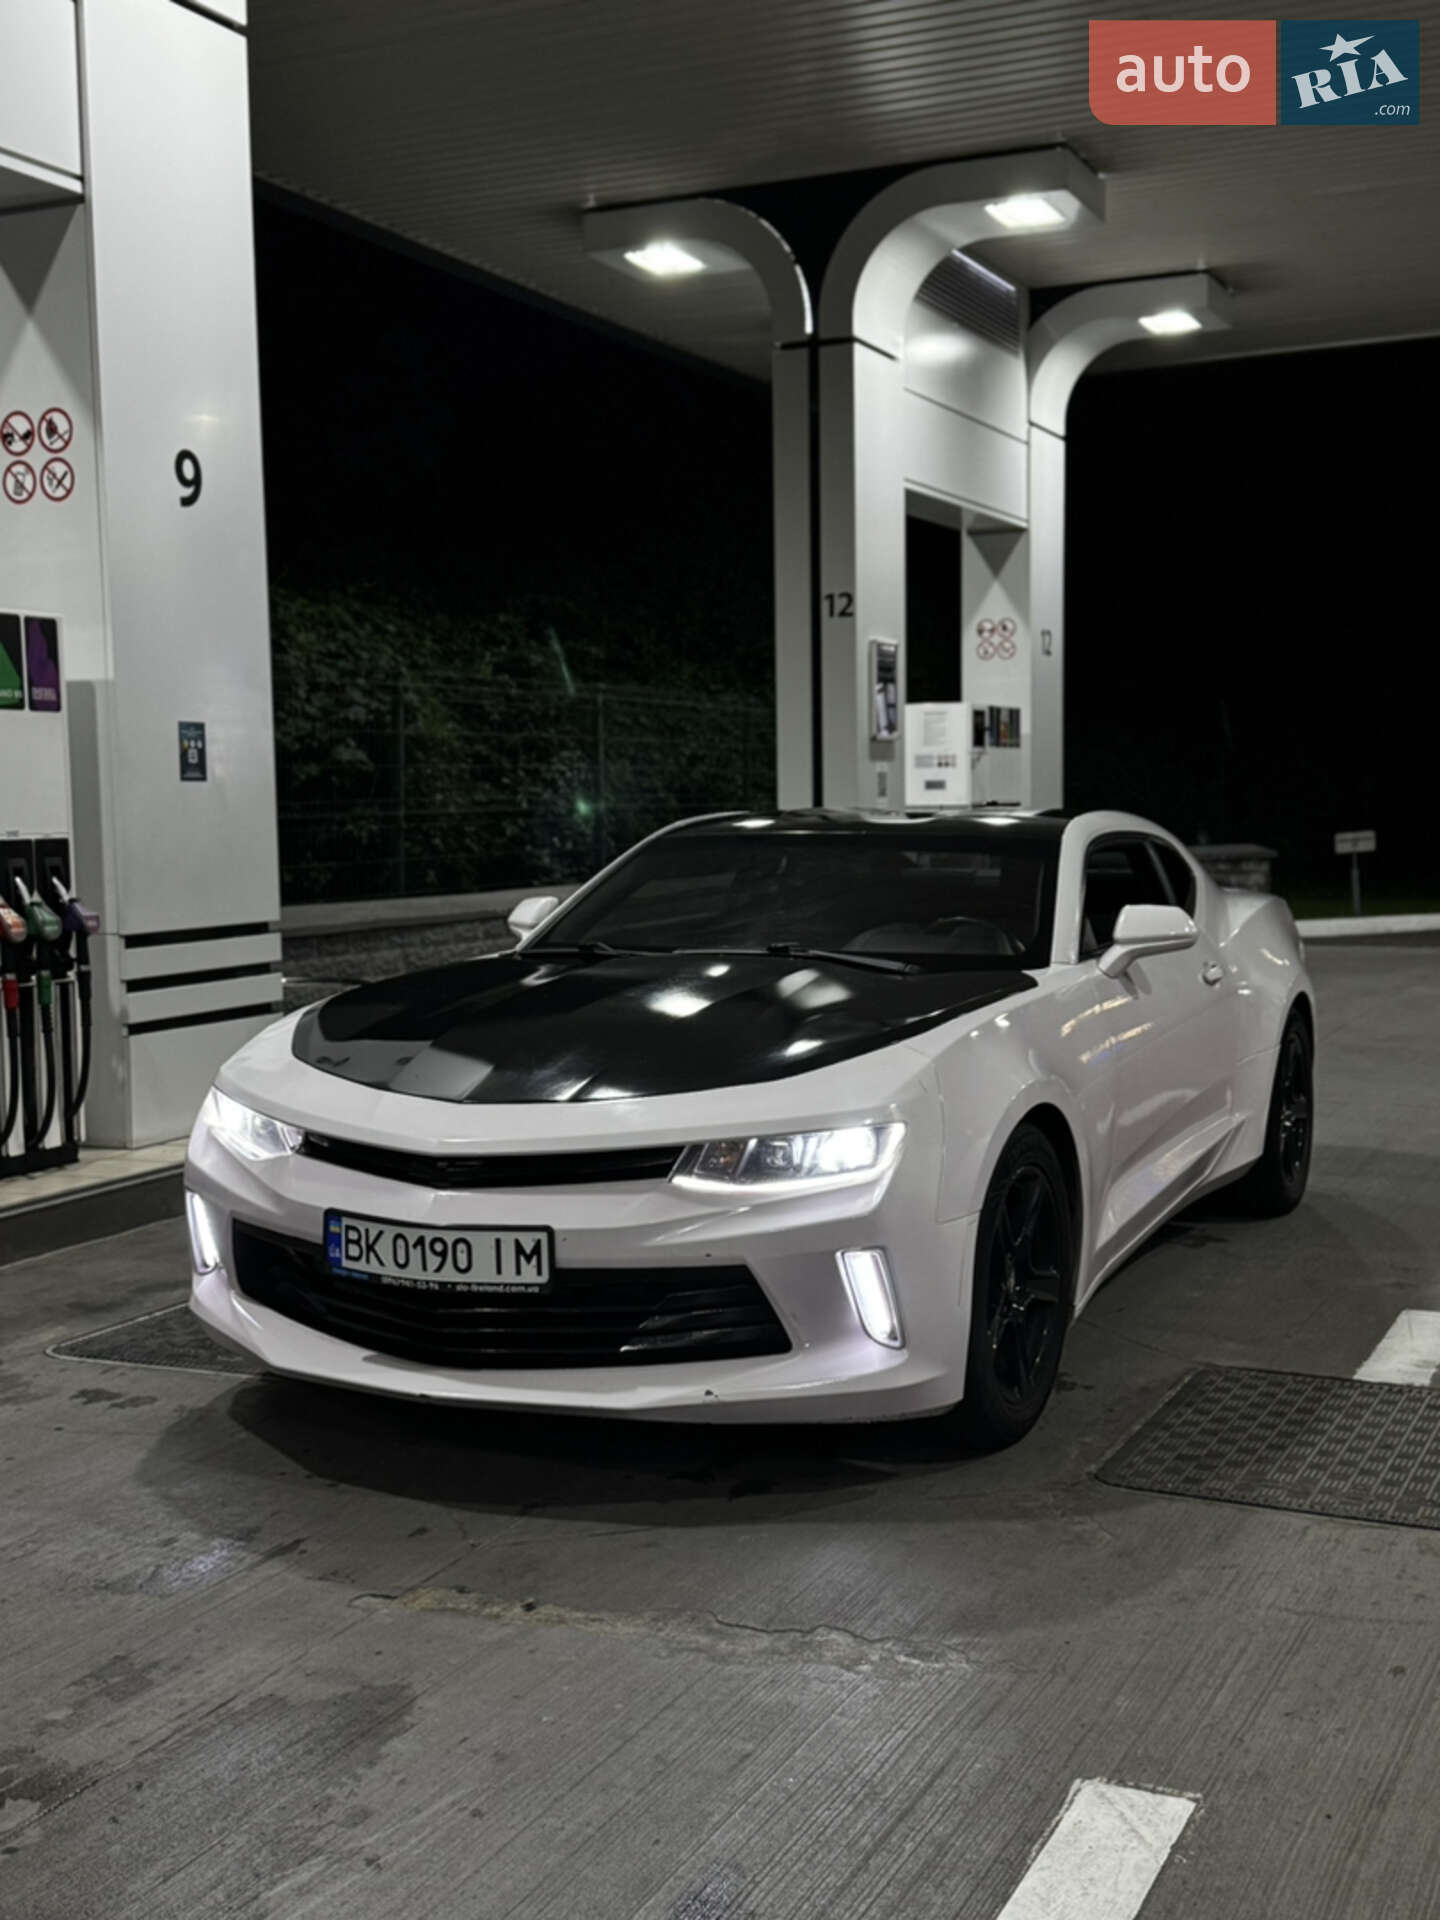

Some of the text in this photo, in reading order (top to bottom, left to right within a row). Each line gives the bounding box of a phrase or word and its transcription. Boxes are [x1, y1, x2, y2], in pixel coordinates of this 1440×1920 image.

[174, 448, 202, 507] 9
[824, 592, 854, 618] 12
[344, 1224, 386, 1267] BK
[392, 1232, 474, 1275] 0190
